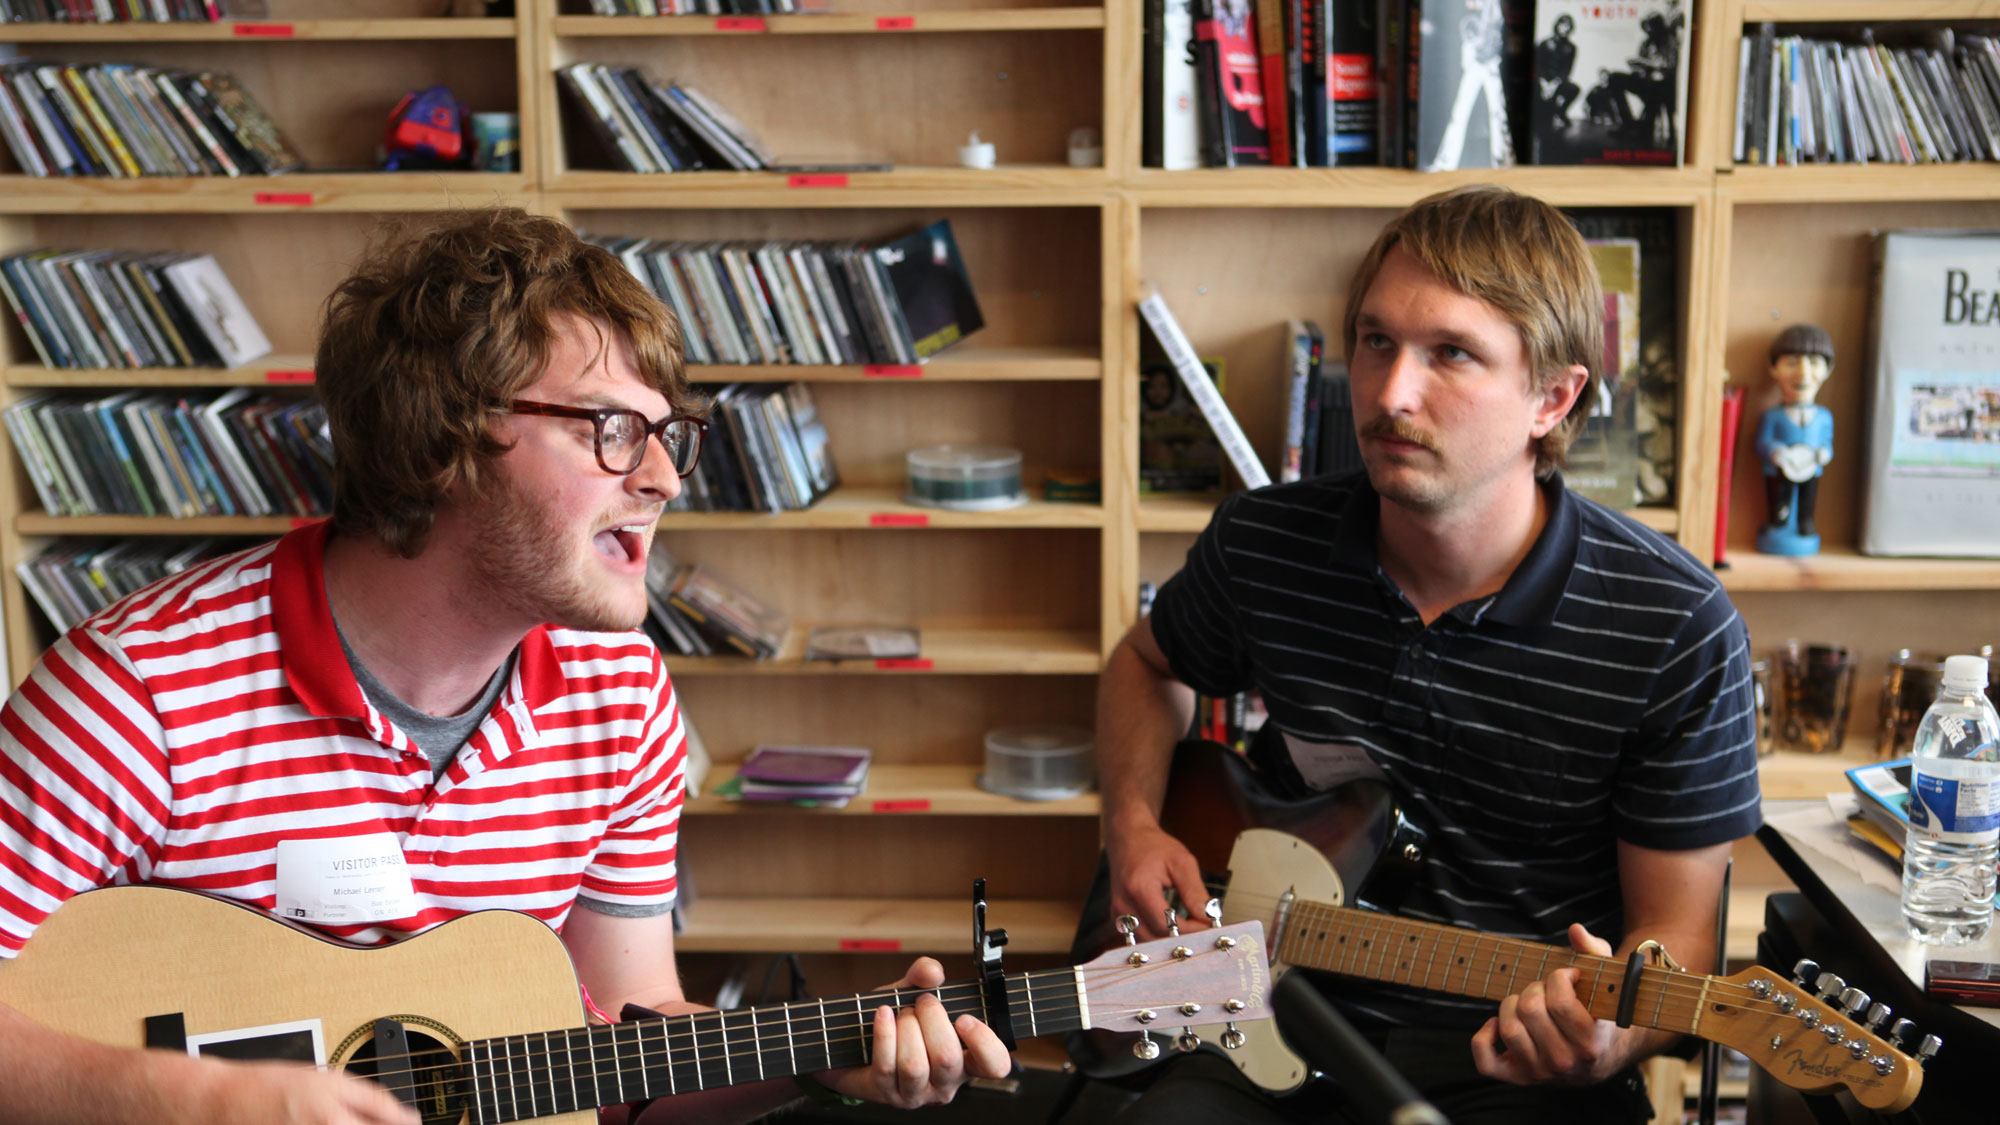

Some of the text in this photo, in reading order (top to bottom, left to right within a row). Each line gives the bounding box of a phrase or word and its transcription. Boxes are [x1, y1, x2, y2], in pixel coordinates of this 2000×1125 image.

[332, 854, 401, 871] VISITOR PASS
[333, 887, 362, 896] Michael
[1783, 1049, 1840, 1077] Fender
